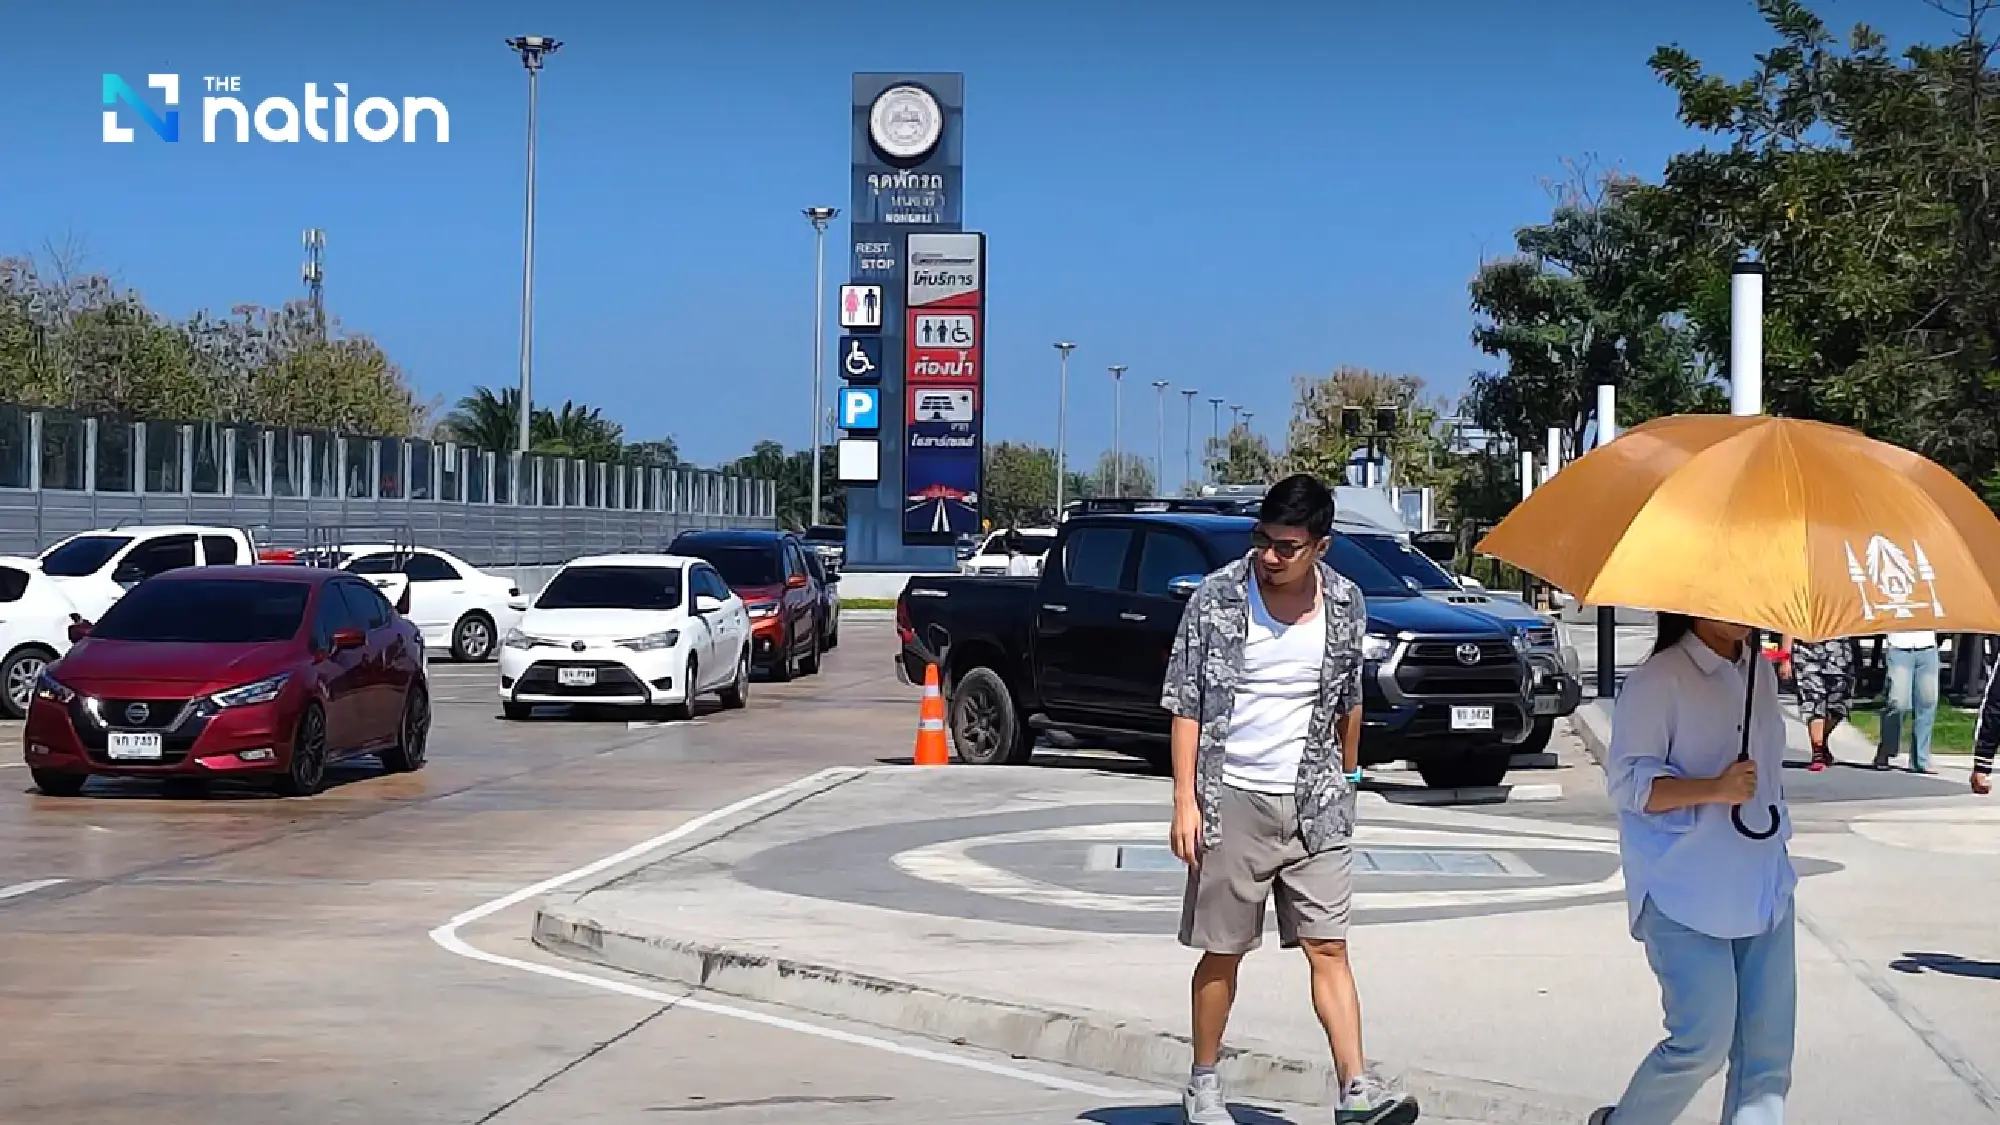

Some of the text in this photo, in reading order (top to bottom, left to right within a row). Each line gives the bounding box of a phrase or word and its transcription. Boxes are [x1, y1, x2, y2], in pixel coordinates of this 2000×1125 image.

[855, 242, 890, 253] REST
[861, 259, 895, 269] STOP
[914, 350, 973, 376] ห้องน้ำ
[846, 392, 873, 424] P
